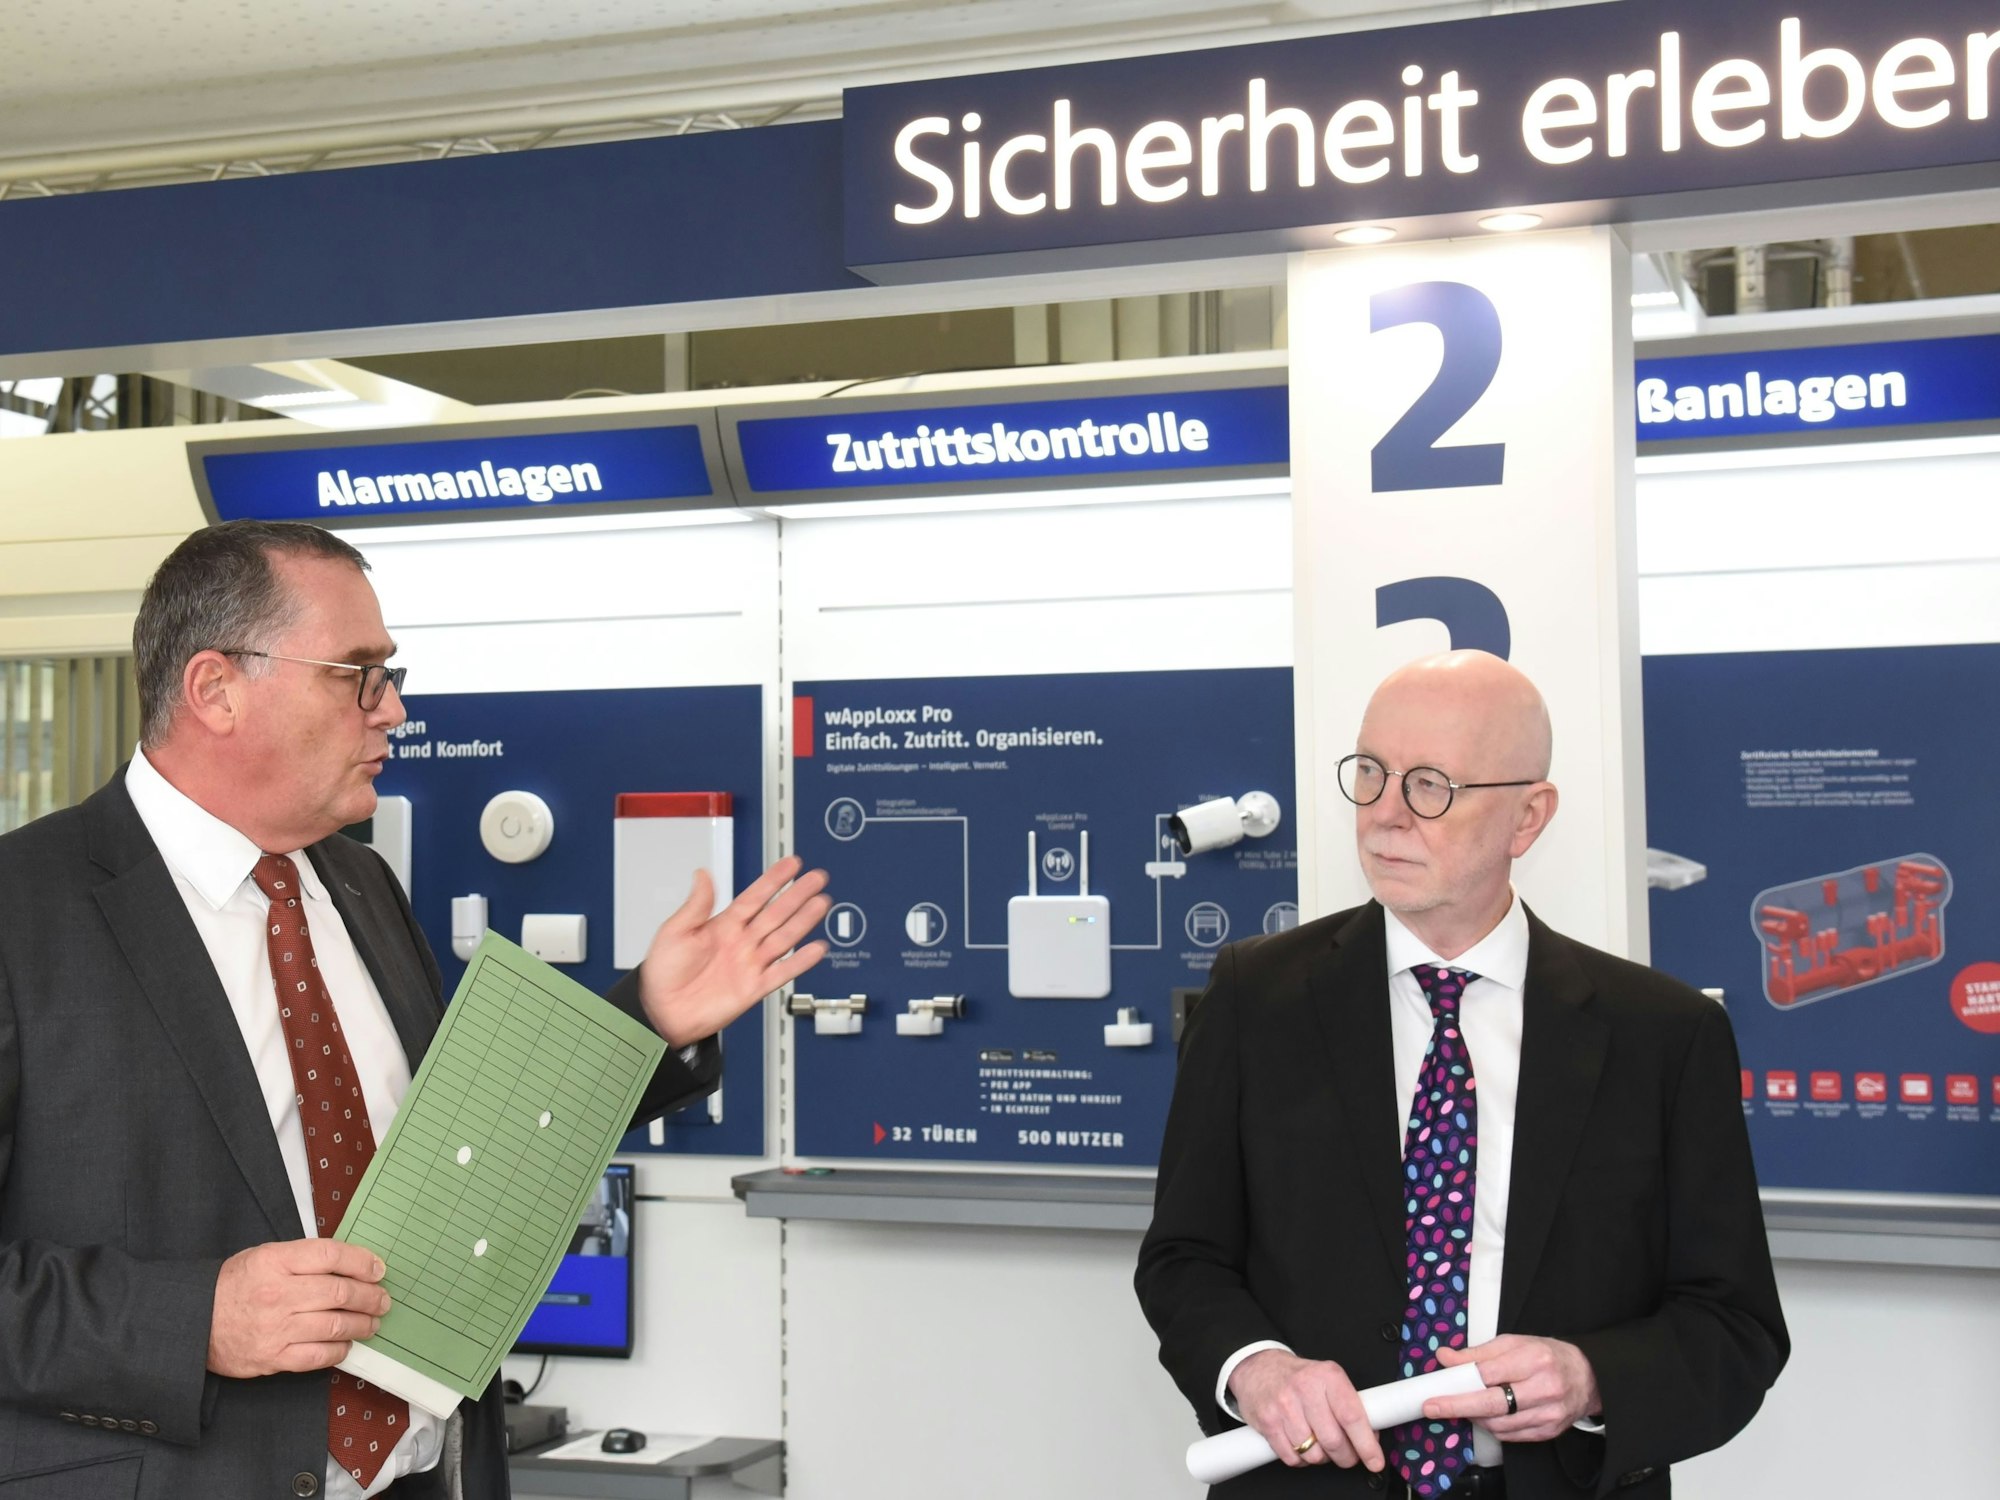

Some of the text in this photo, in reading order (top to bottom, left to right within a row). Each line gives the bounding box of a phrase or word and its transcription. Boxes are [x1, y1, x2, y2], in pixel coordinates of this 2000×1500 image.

[894, 64, 1479, 225] Sicherheit
[1370, 281, 1506, 493] 2
[1637, 371, 1907, 423] ßanlagen
[827, 411, 1209, 472] Zutrittskontrolle
[317, 461, 602, 507] Alarmanlagen
[825, 706, 952, 728] wAppLoxx Pro
[399, 741, 431, 758] und
[436, 739, 504, 758] Komfort
[825, 727, 1103, 751] Einfach. Zutritt. Organisieren.
[892, 1124, 978, 1143] 32 TÜREN
[1017, 1130, 1124, 1148] 500 NUTZER
